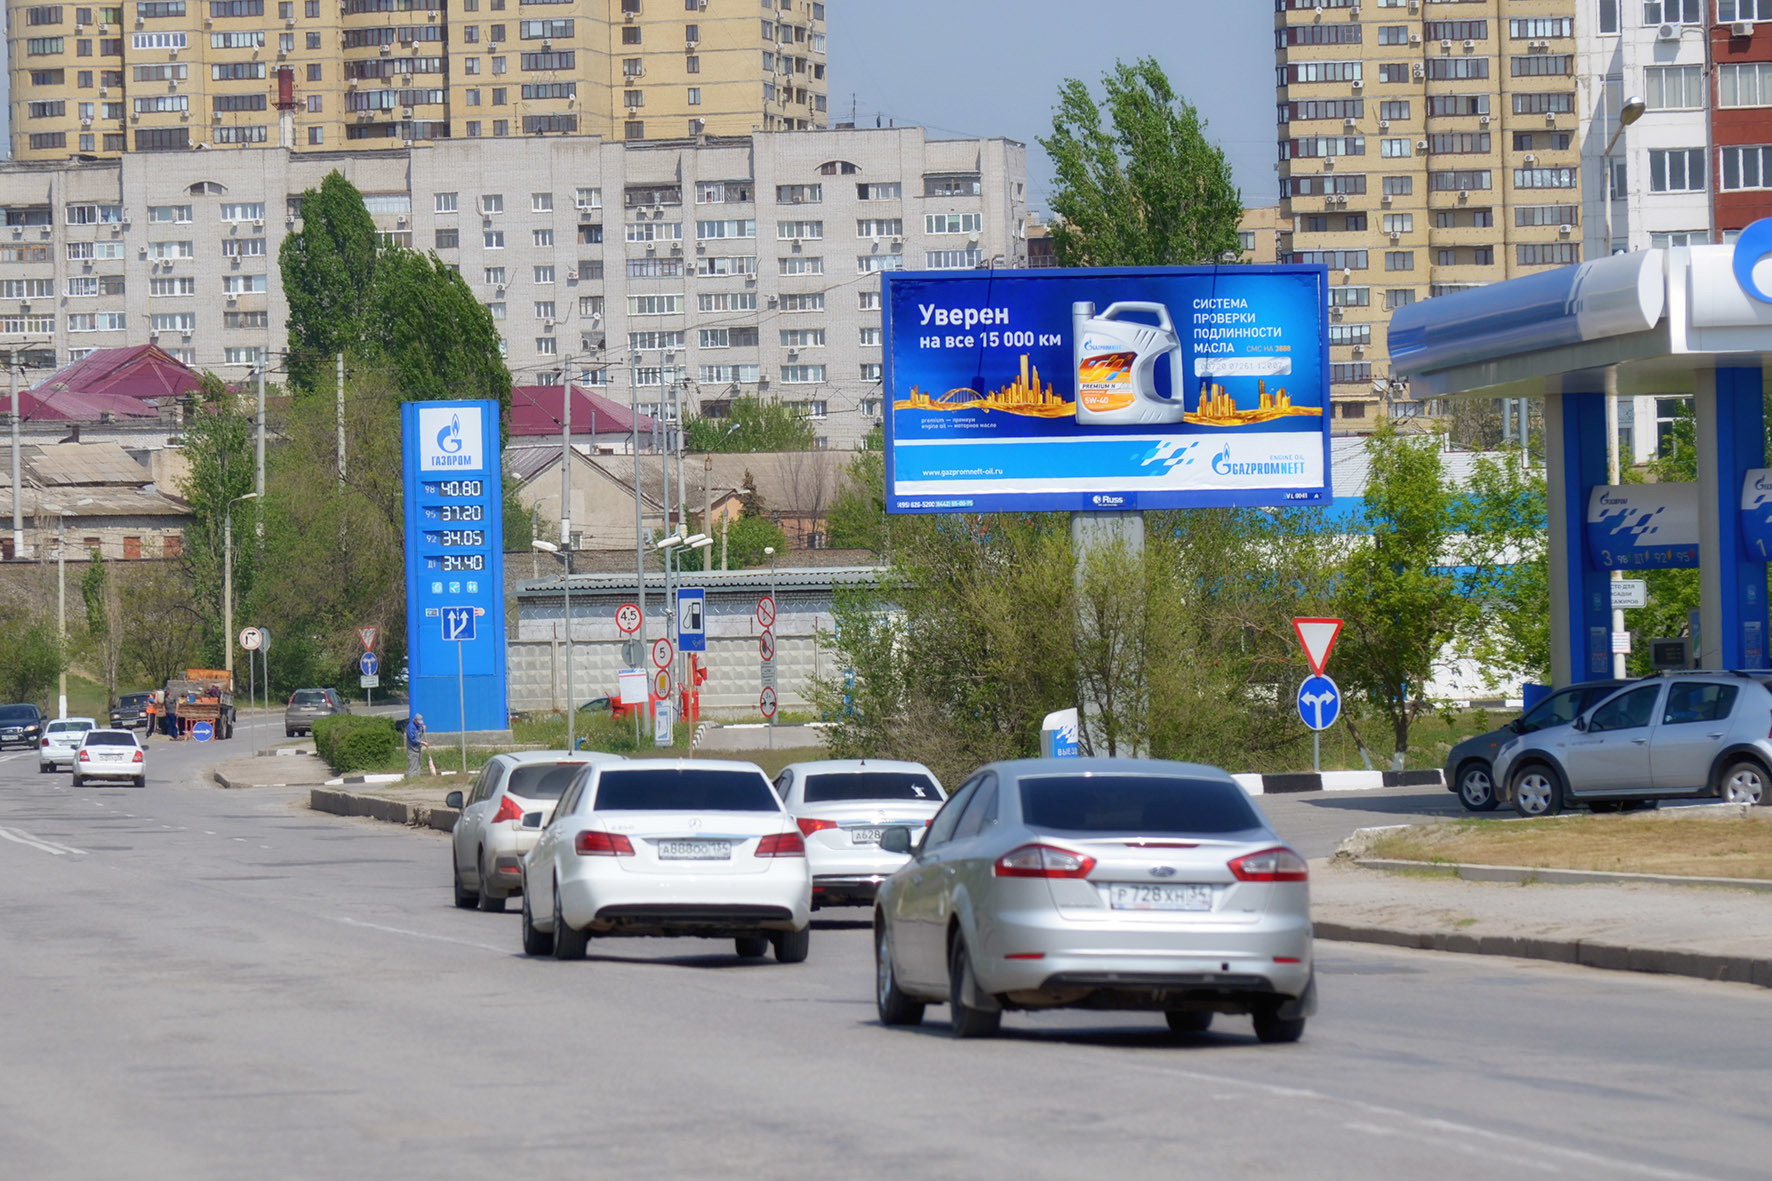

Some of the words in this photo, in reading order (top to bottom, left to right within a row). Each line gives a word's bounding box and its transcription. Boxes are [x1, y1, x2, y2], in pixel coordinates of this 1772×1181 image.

[1193, 298, 1248, 309] СИСТЕМА
[918, 304, 1009, 330] Уверен
[1193, 313, 1256, 324] ПРОВЕРКИ
[920, 336, 941, 349] на
[945, 335, 975, 348] все
[979, 332, 1000, 348] 15
[1003, 331, 1035, 347] 000
[1038, 334, 1062, 346] км
[1194, 327, 1282, 340] ПОДЛИННОСТИ
[1194, 343, 1235, 353] МАСЛА
[1246, 345, 1262, 353] СМС
[431, 455, 472, 467] ГАЗПРОМ
[922, 467, 1004, 477] www.gazpromneft-oil.ru
[1232, 462, 1305, 475] GAZPROMNEFT
[425, 486, 436, 494] 98
[441, 481, 481, 496] 40.80
[1102, 495, 1124, 503] Russ
[425, 510, 437, 518] 95
[442, 505, 482, 521] 37.20
[426, 535, 437, 543] 92
[443, 530, 482, 546] 34.05
[443, 555, 482, 571] 34.40
[1601, 550, 1613, 566] 3
[659, 647, 666, 659] 5
[1117, 886, 1185, 902] Р728ХН
